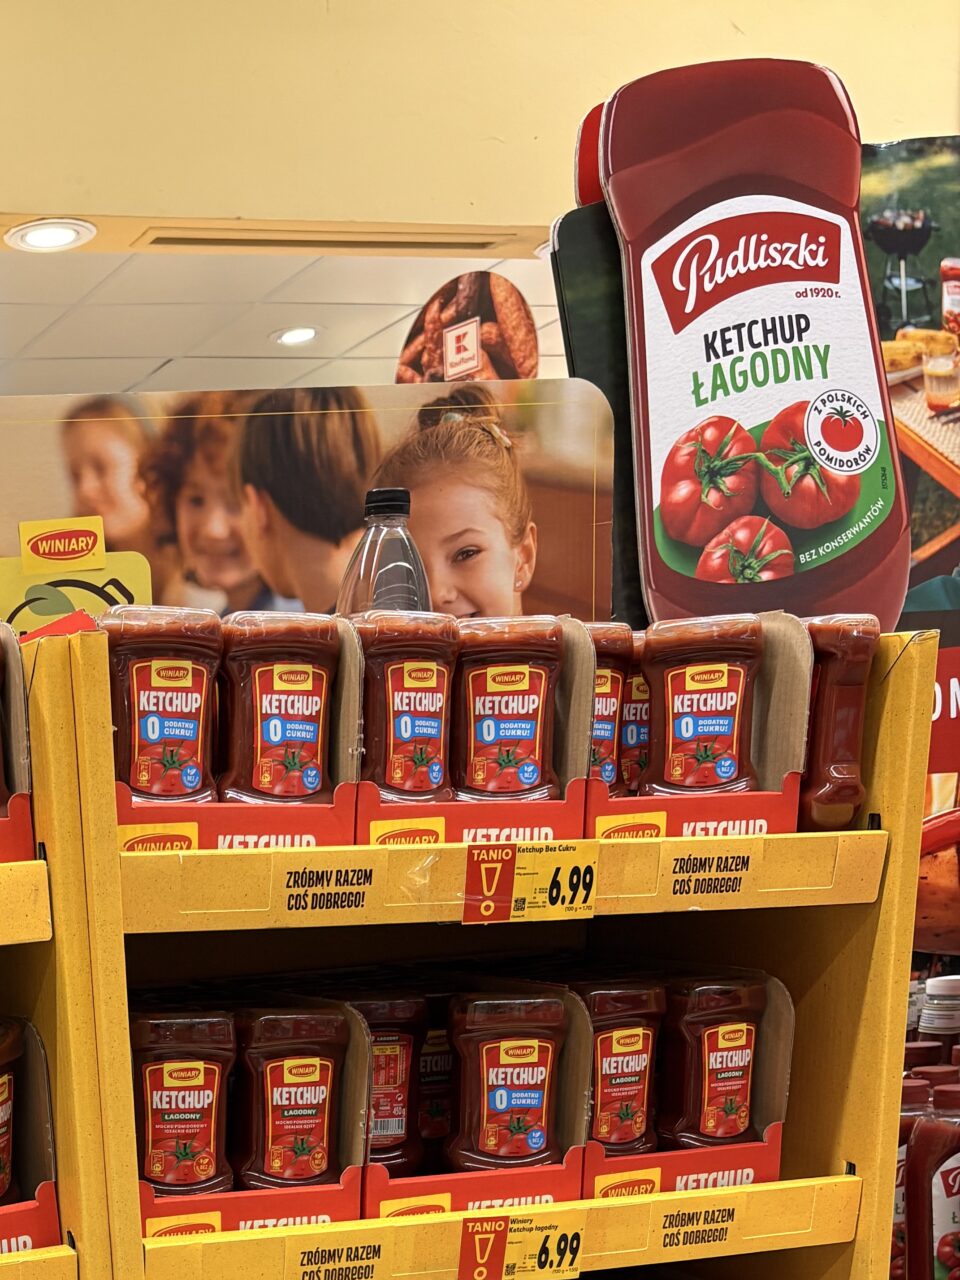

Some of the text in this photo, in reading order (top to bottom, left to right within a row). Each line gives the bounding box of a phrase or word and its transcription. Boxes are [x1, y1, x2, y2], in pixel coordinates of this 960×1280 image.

[672, 233, 828, 313] Pudliszki
[795, 287, 841, 298] od 1920 r.
[703, 313, 811, 362] KETCHUP
[691, 344, 831, 408] ŁAGODNY
[813, 393, 869, 420] Z POLSKICH
[813, 440, 873, 468] POMIDORÓW
[799, 497, 885, 564] BEZ KONSERWANTÓW
[38, 535, 94, 554] WINIARY
[160, 668, 187, 679] WINIARY
[694, 670, 723, 682] WINIARY
[139, 690, 201, 713] KETCHUP
[475, 693, 539, 716] KETCHUP
[673, 691, 737, 714] KETCHUP
[680, 716, 693, 740] 0
[698, 719, 729, 727] DODATKU
[699, 726, 728, 734] CUKRU!
[472, 848, 512, 861] TANIO
[517, 844, 576, 855] Ketchup Bez Cukru
[285, 869, 333, 889] ZRÓBMY
[548, 865, 594, 906] 6.99
[286, 889, 308, 910] COŚ
[488, 1066, 546, 1086] KETCHUP
[152, 1089, 213, 1109] KETCHUP
[467, 1220, 505, 1232] TANIO
[509, 1225, 534, 1234] Ketchup
[510, 1217, 533, 1226] Winiary
[662, 1210, 702, 1229] ZRÓBMY
[662, 1227, 681, 1248] COŚ
[537, 1232, 581, 1269] 6.99
